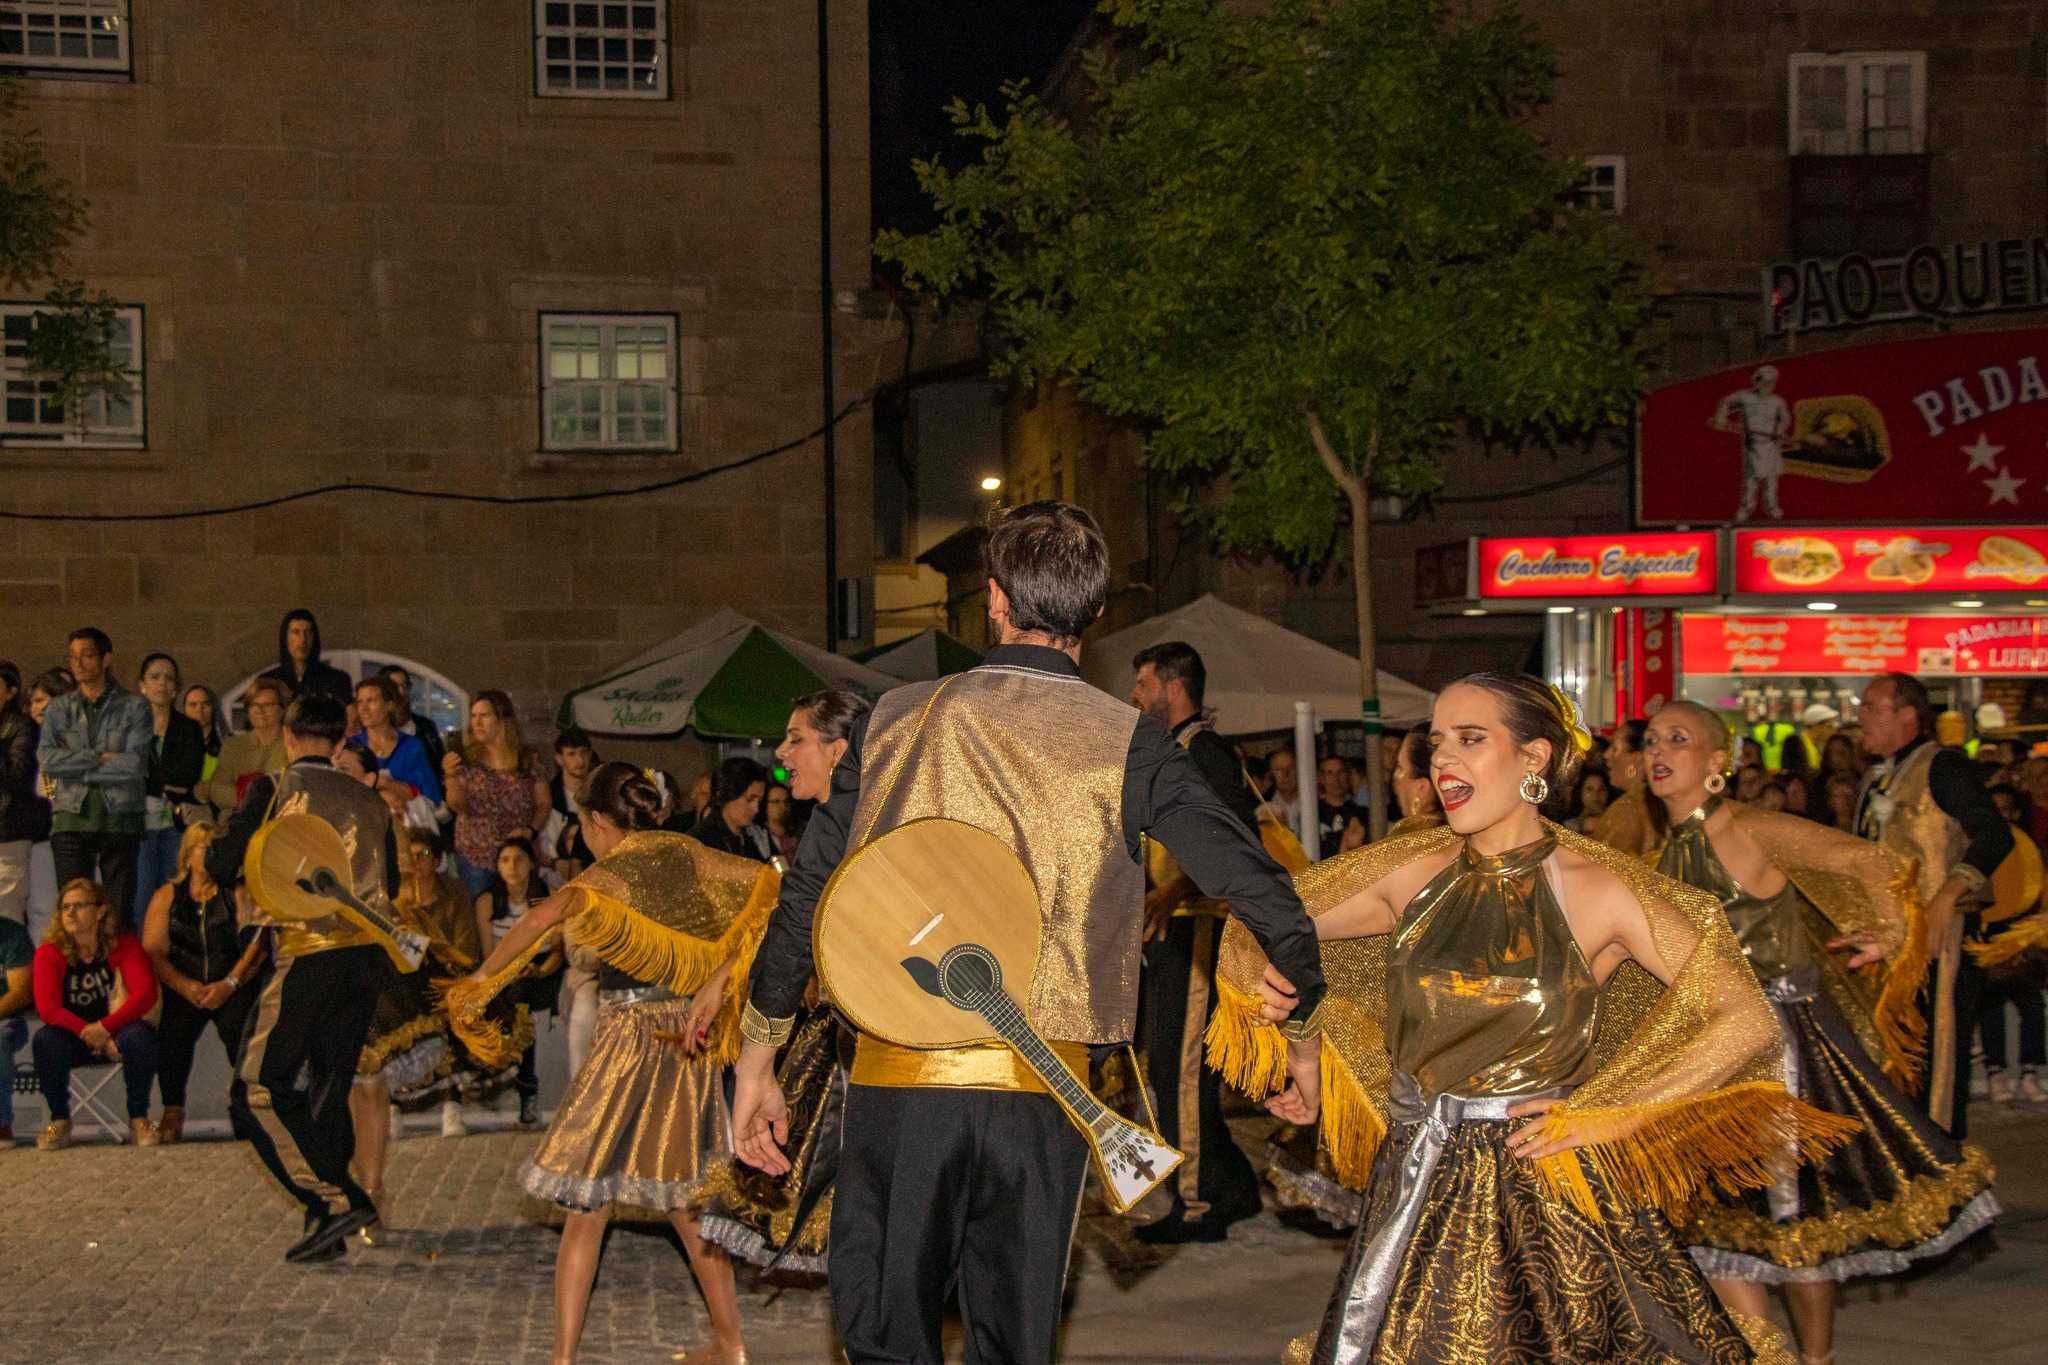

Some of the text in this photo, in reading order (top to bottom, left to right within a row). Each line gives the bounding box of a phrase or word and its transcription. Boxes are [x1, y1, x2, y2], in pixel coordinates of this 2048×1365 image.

[1912, 357, 2048, 437] PADA
[1497, 546, 1699, 586] Cachorro Especial
